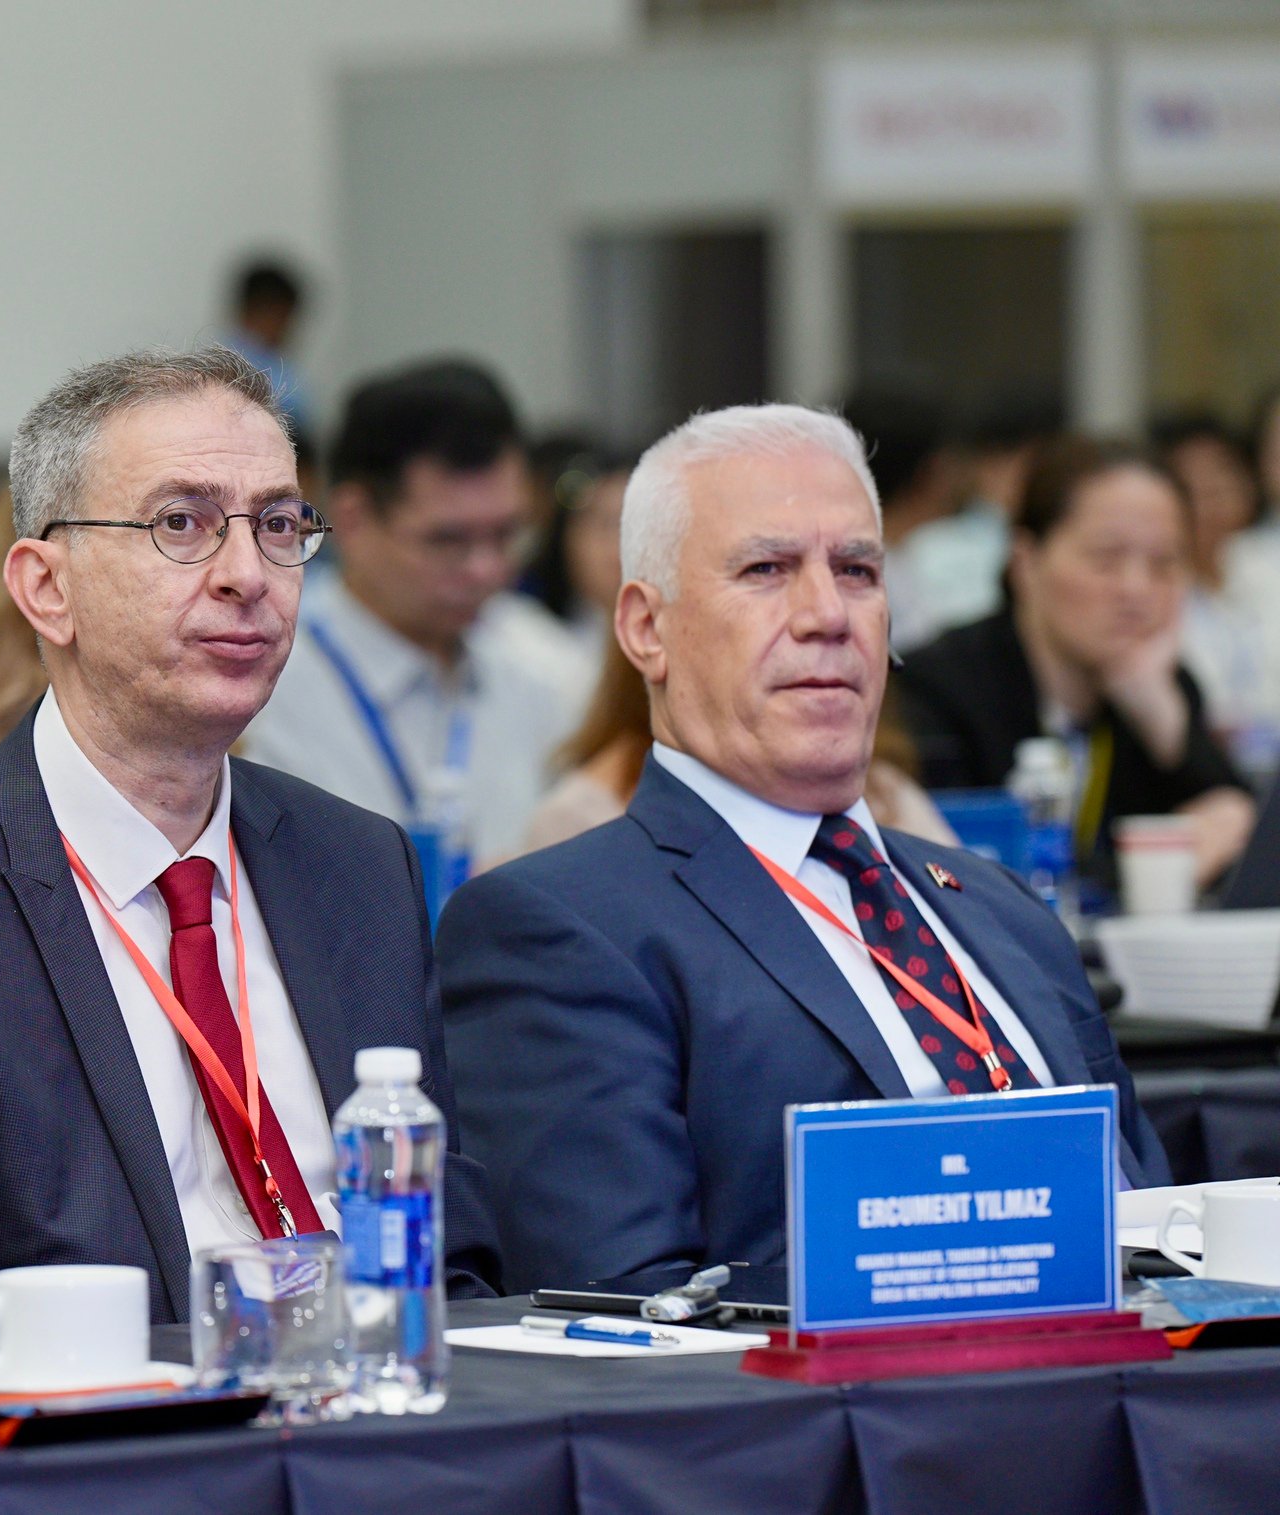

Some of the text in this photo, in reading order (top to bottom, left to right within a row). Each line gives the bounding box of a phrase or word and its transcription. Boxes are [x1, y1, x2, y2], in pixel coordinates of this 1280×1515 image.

[942, 1155, 969, 1175] MR.
[859, 1188, 1051, 1228] ERCUMENT YILMAZ
[976, 1278, 1039, 1295] MUNICIPALITY
